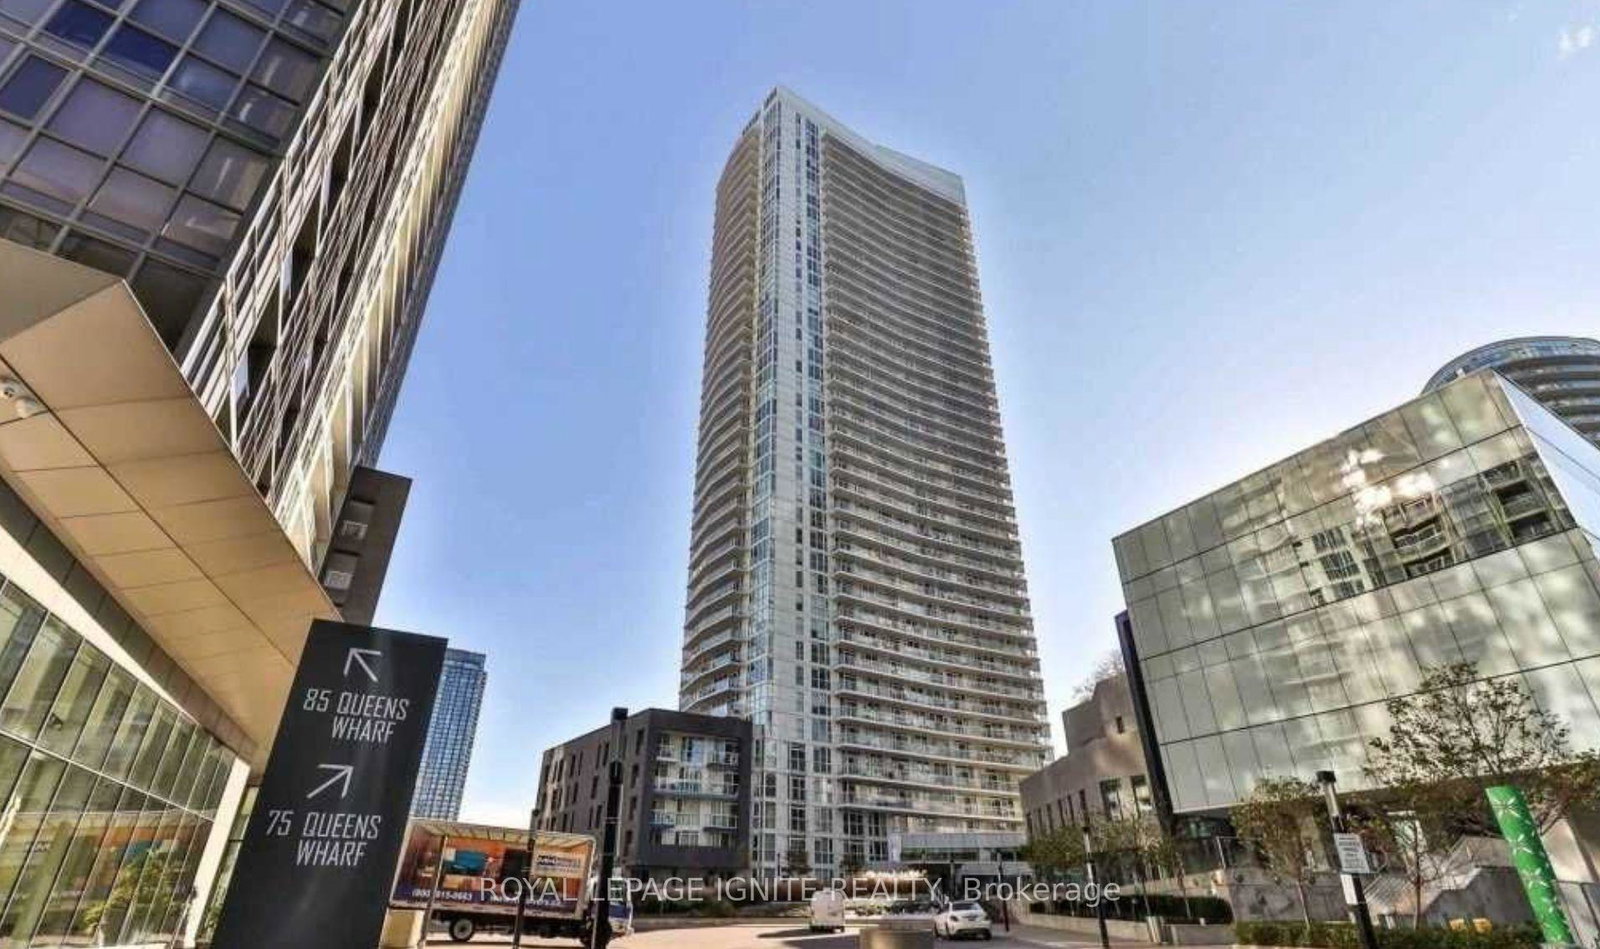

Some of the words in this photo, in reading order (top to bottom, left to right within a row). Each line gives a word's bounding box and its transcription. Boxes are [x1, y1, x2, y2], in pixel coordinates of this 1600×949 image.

[303, 688, 332, 713] 85
[336, 691, 410, 721] QUEENS
[332, 716, 396, 744] WHARF
[266, 810, 295, 836] 75
[302, 811, 381, 840] QUEENS
[296, 839, 367, 866] WHARF
